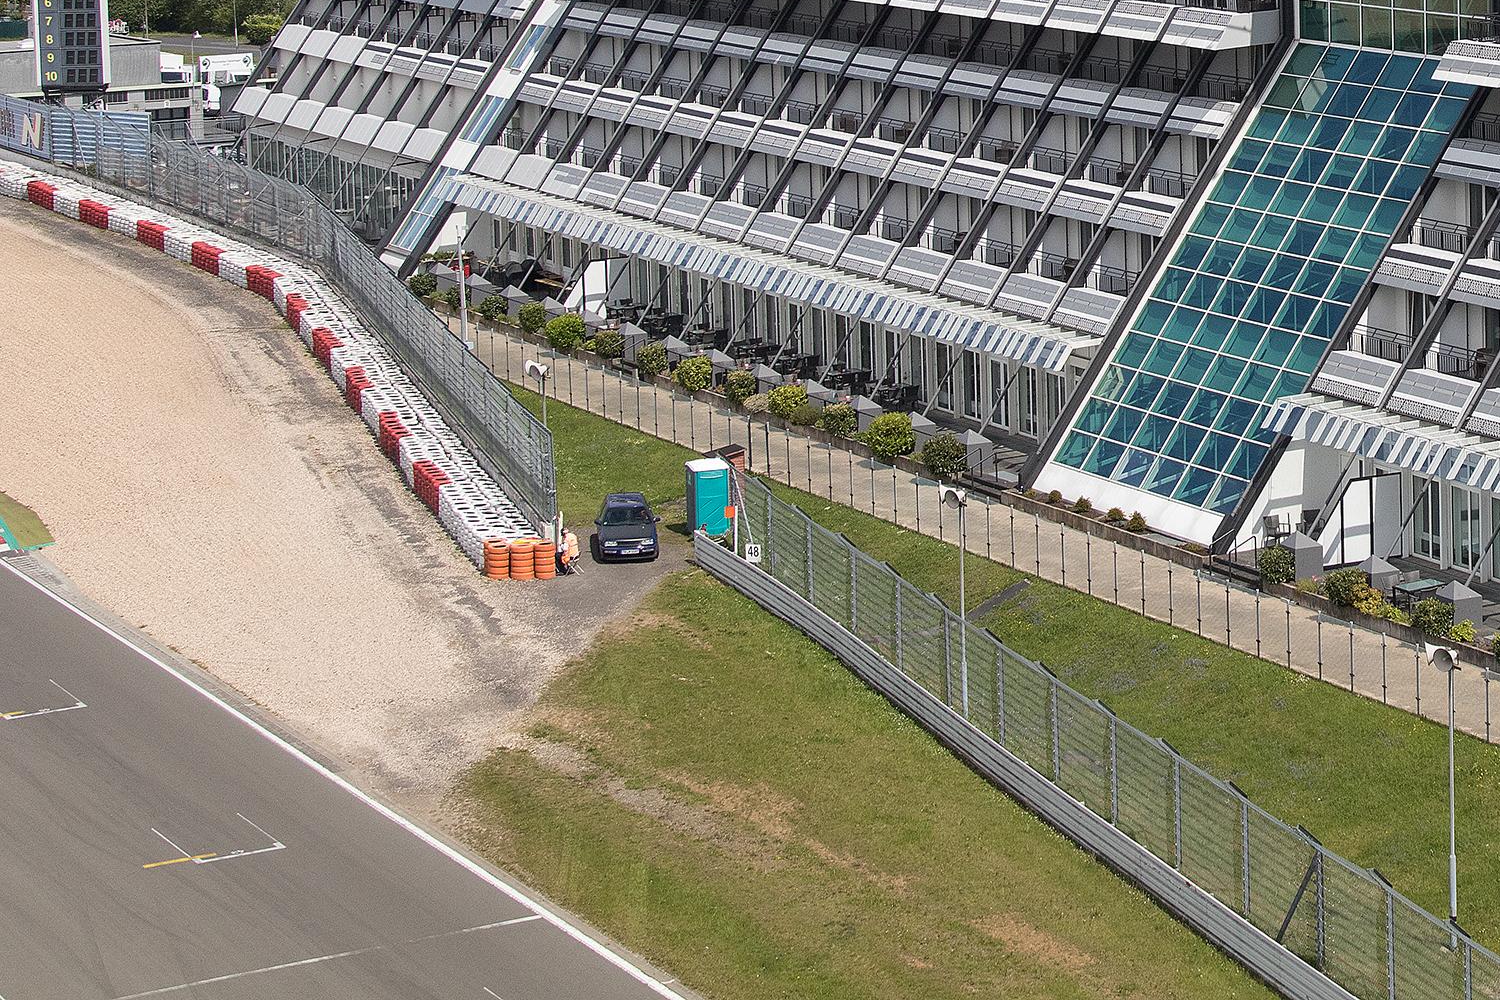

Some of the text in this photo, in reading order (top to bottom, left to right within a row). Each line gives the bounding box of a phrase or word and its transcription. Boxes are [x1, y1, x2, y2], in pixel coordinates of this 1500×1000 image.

[45, 16, 53, 26] 7
[46, 34, 54, 44] 8
[47, 53, 55, 63] 9
[45, 72, 58, 81] 10
[747, 546, 760, 557] 48
